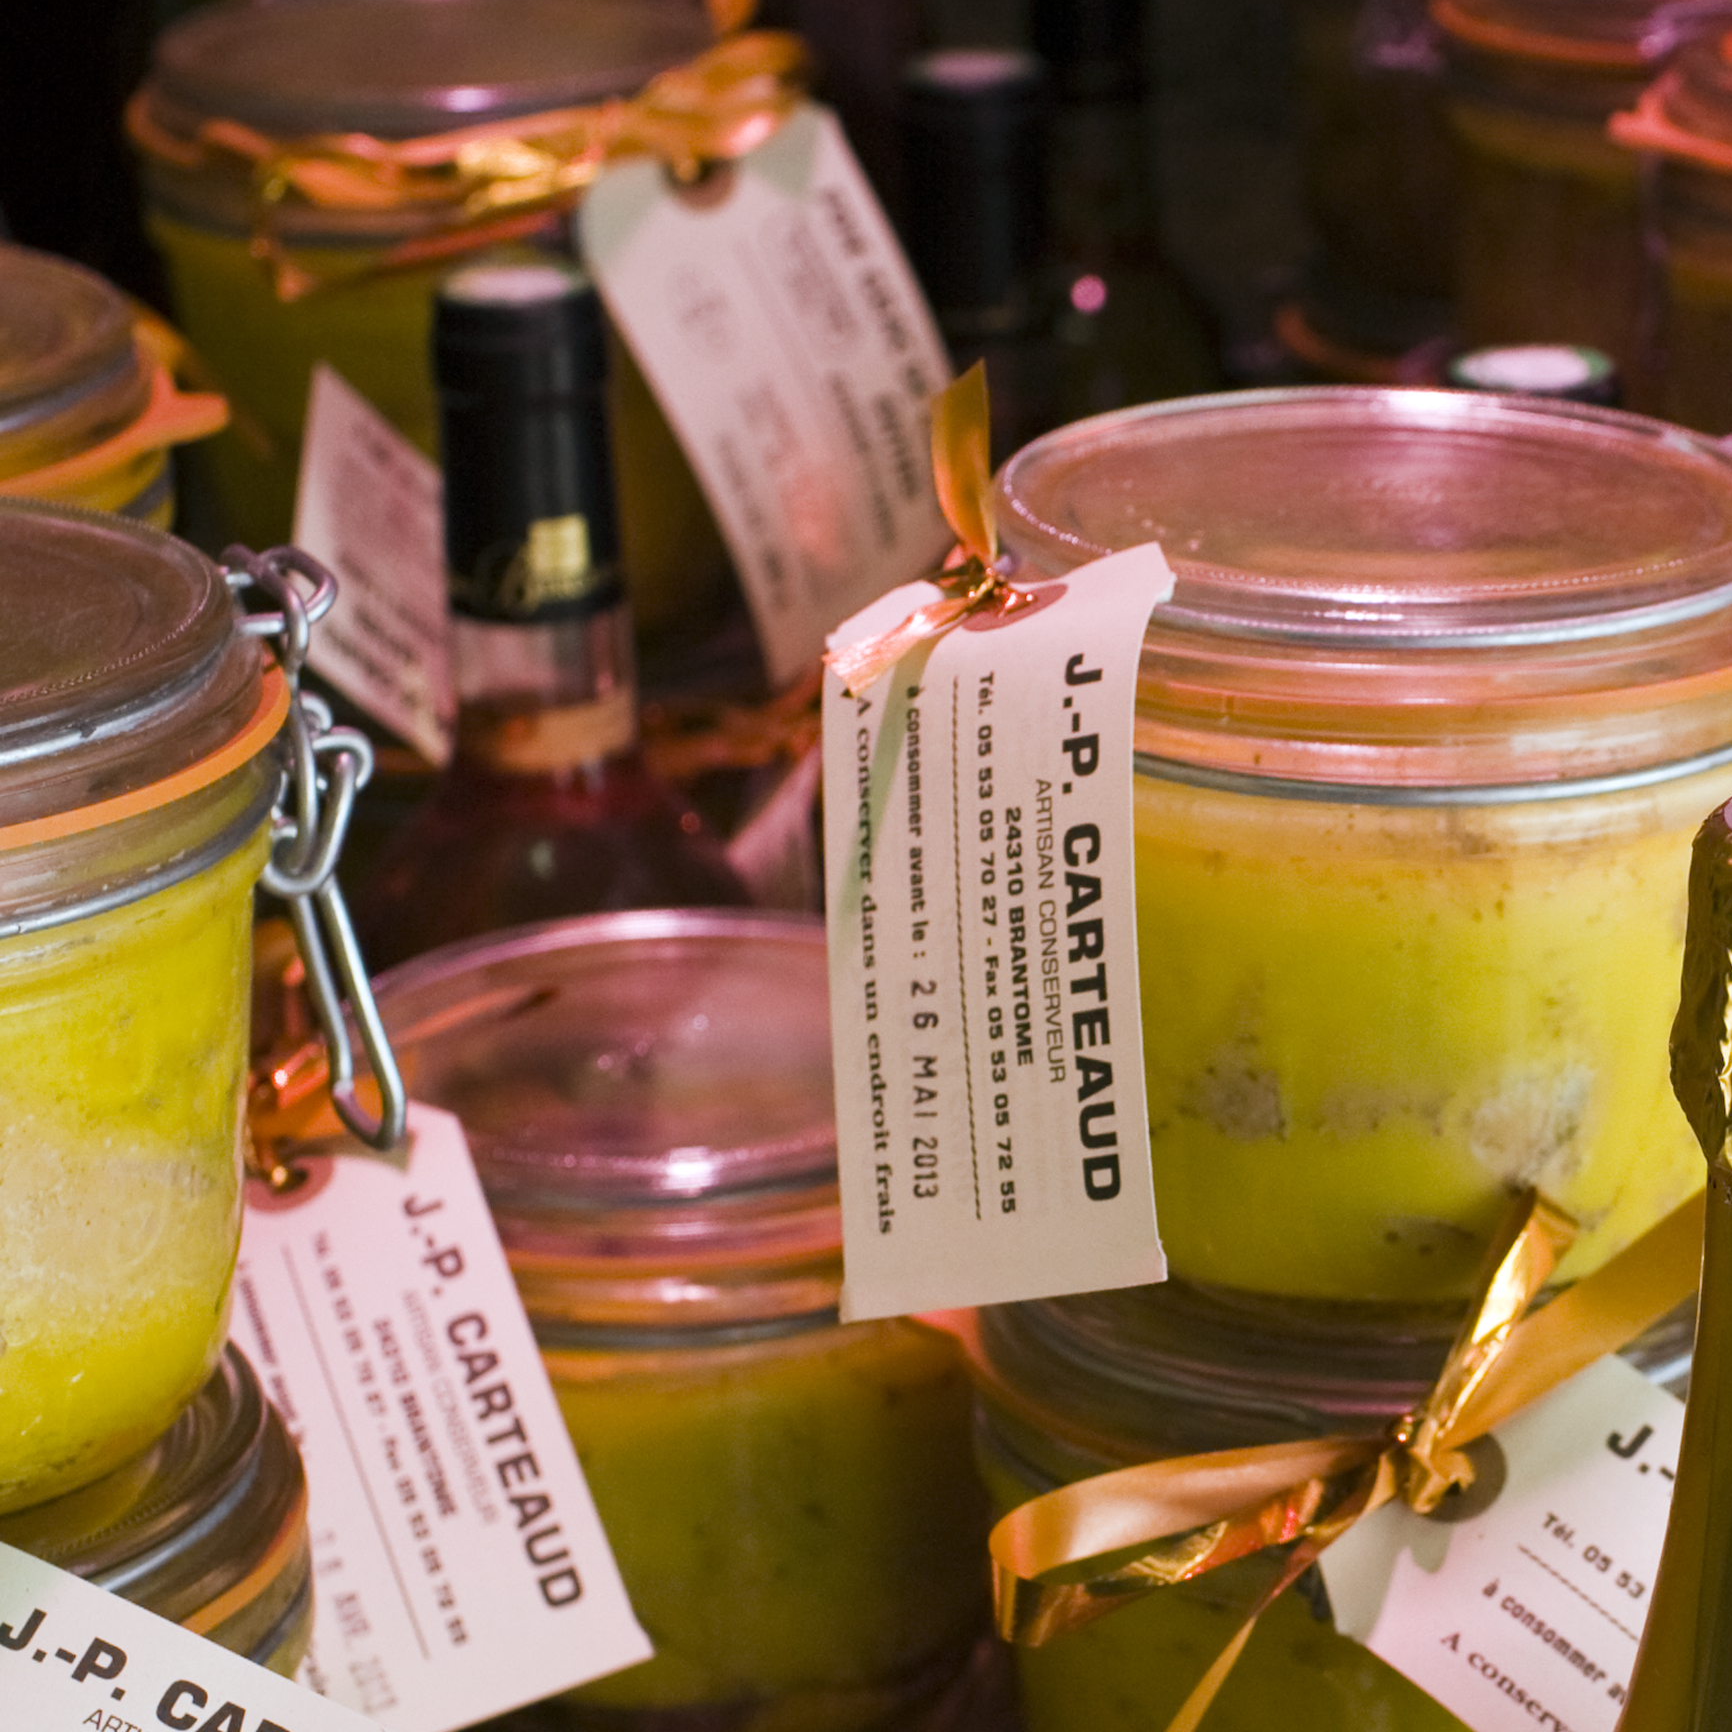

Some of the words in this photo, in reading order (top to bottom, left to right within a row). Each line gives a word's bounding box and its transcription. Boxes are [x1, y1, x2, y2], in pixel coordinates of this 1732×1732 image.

[978, 671, 994, 715] Tél.
[1063, 653, 1103, 796] J.-P.
[907, 708, 922, 837] consommer
[977, 725, 992, 757] 05
[857, 728, 874, 883] conserver
[978, 767, 993, 800] 53
[979, 810, 994, 843] 05
[1005, 806, 1024, 896] 24310
[1036, 778, 1056, 889] ARTISAN
[909, 847, 926, 913] avant
[980, 852, 995, 885] 70
[861, 894, 877, 969] dans
[982, 896, 997, 928] 27
[864, 979, 879, 1022] un
[985, 955, 999, 998] Fax
[1009, 905, 1035, 1068] BRANTOME
[1038, 899, 1066, 1084] CONSERVEUR
[987, 1006, 1003, 1040] 05
[1062, 821, 1121, 1203] CARTEAUD
[867, 1032, 890, 1152] endroit
[912, 1055, 938, 1118] MAI
[991, 1050, 1006, 1084] 53
[994, 1094, 1010, 1127] 05
[912, 1136, 939, 1200] 2013
[997, 1137, 1012, 1171] 72
[876, 1163, 895, 1235] frais
[1000, 1181, 1016, 1215] 55
[403, 1193, 465, 1298] J.-P.
[448, 1312, 583, 1610] CARTEAUD
[1615, 1570, 1646, 1600] 53
[0, 1608, 128, 1701] J.-P.
[1500, 1594, 1607, 1685] consommer
